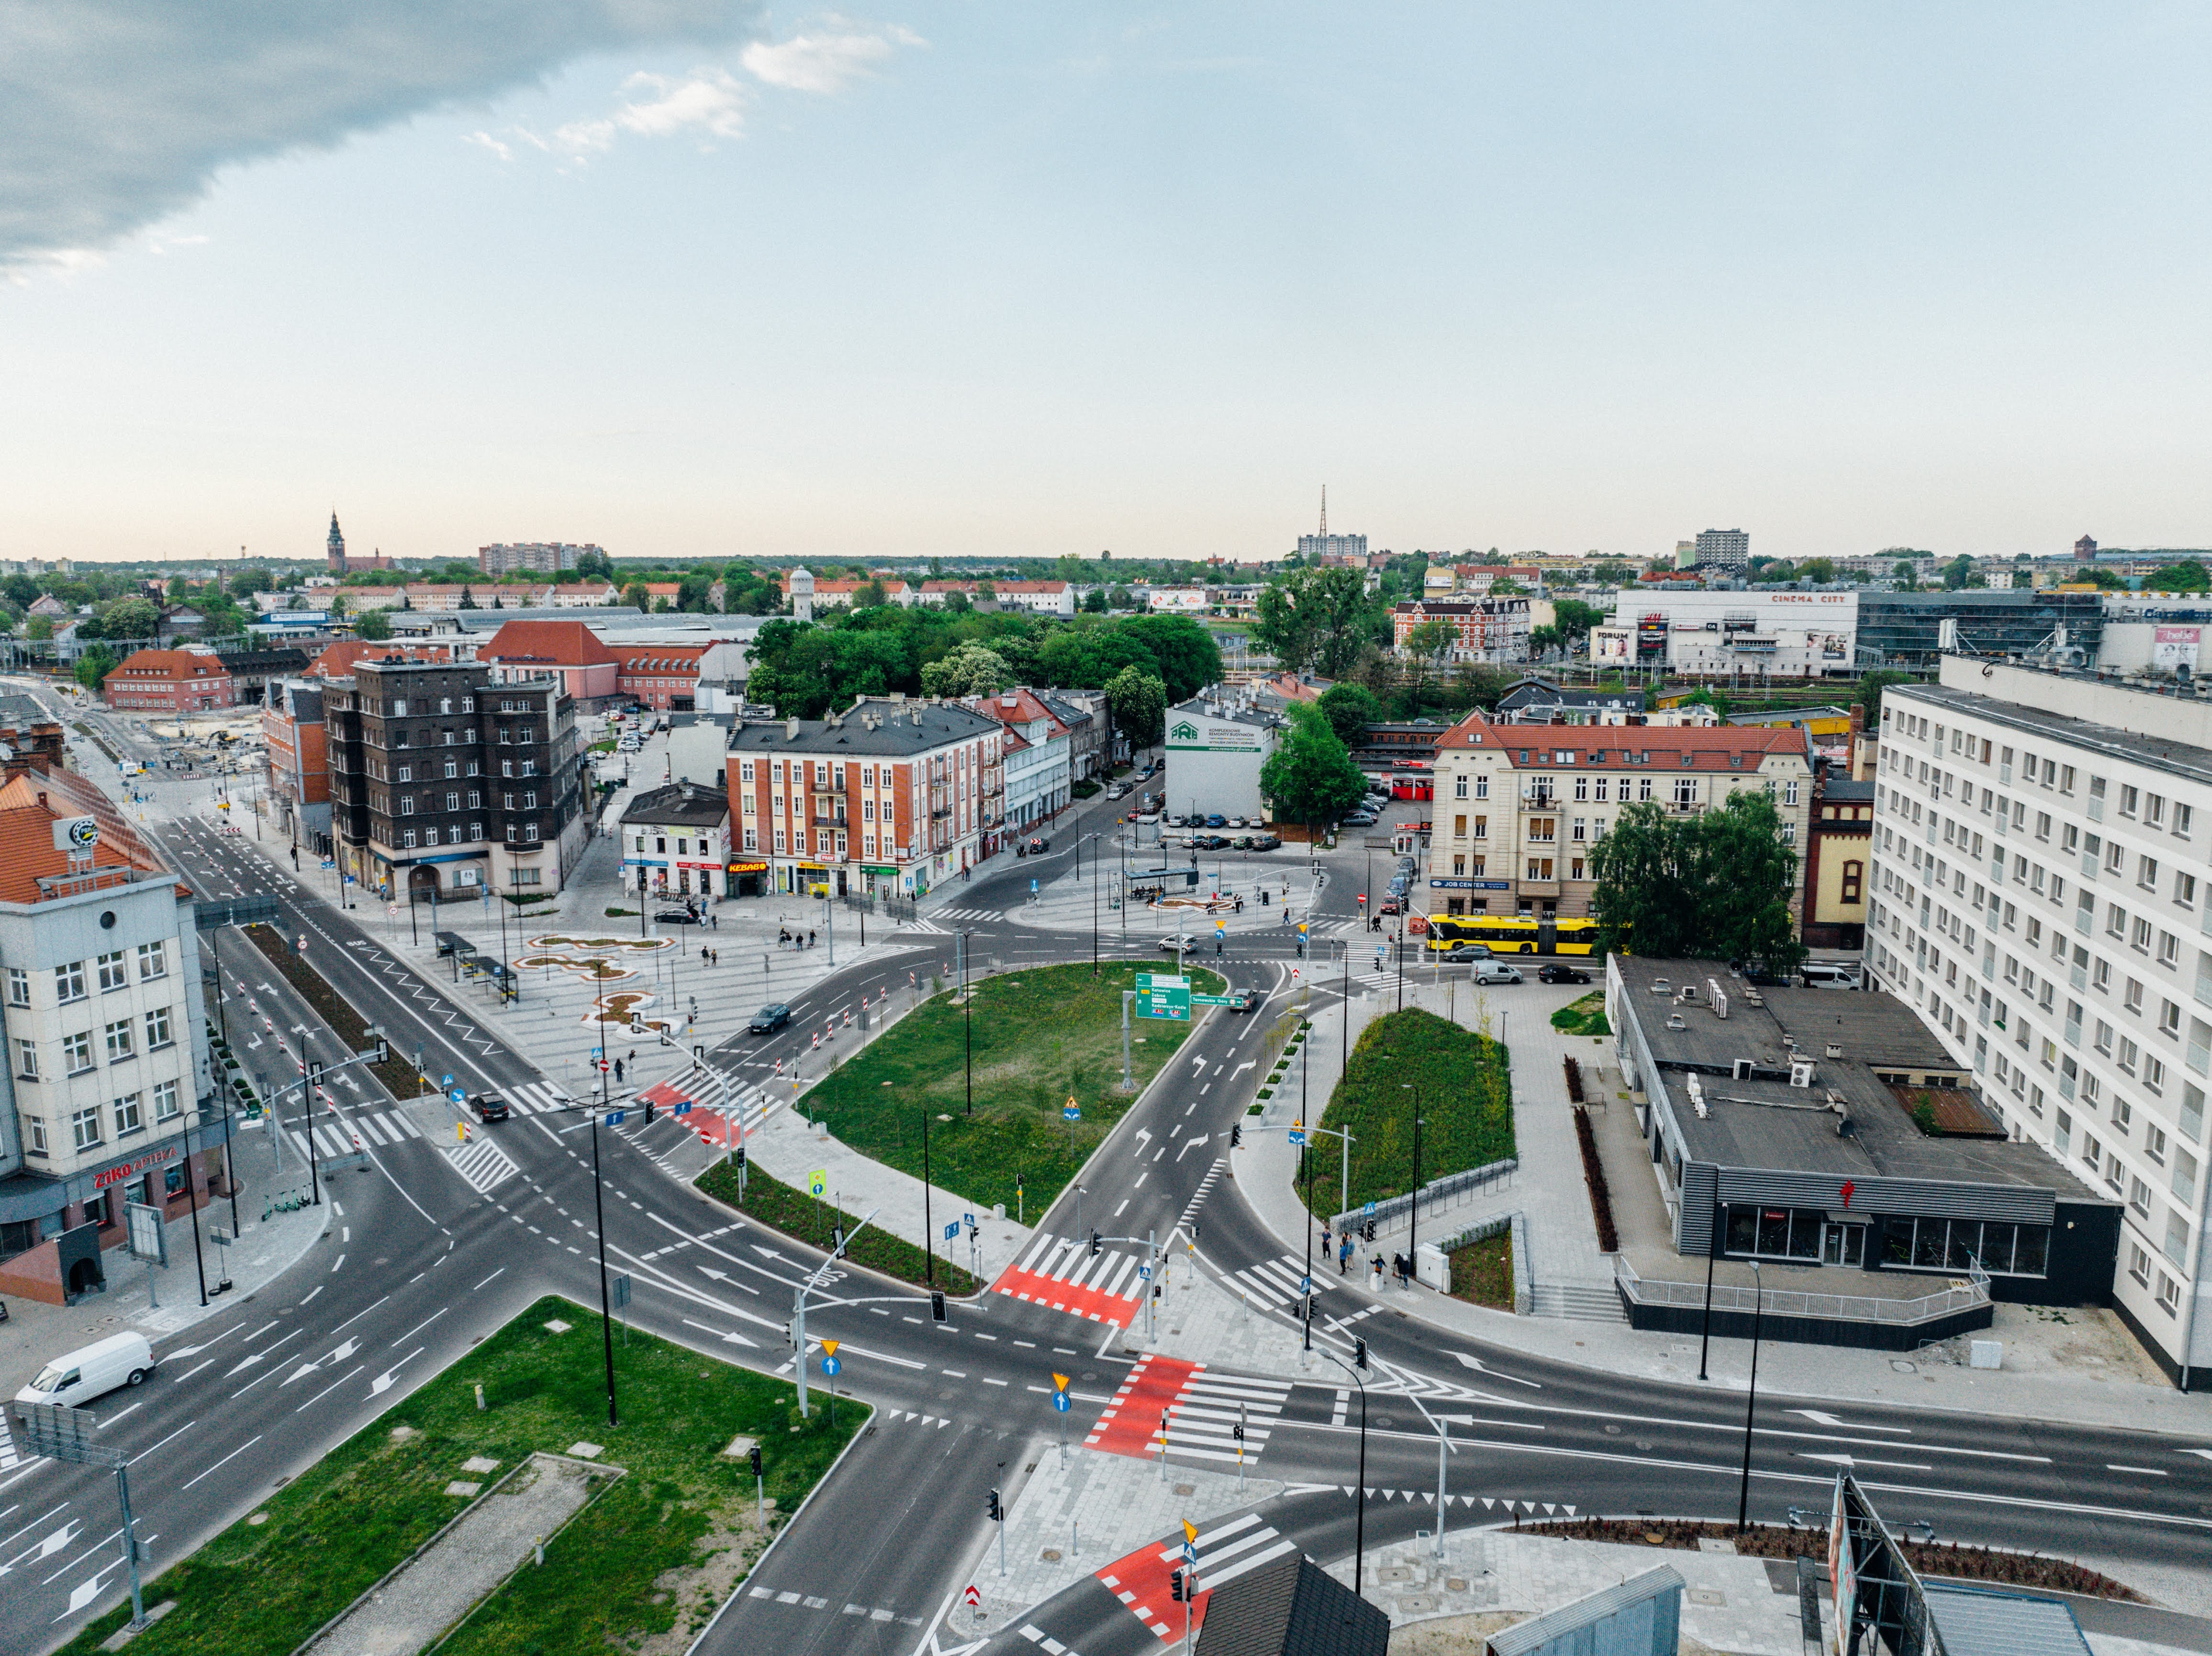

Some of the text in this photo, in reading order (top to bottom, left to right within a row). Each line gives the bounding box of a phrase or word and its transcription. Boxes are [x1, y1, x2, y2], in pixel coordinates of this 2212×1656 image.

[2167, 631, 2194, 640] hebe
[729, 864, 760, 872] KEBAB
[133, 1146, 178, 1172] APTEKA
[803, 1267, 848, 1287] BUS
